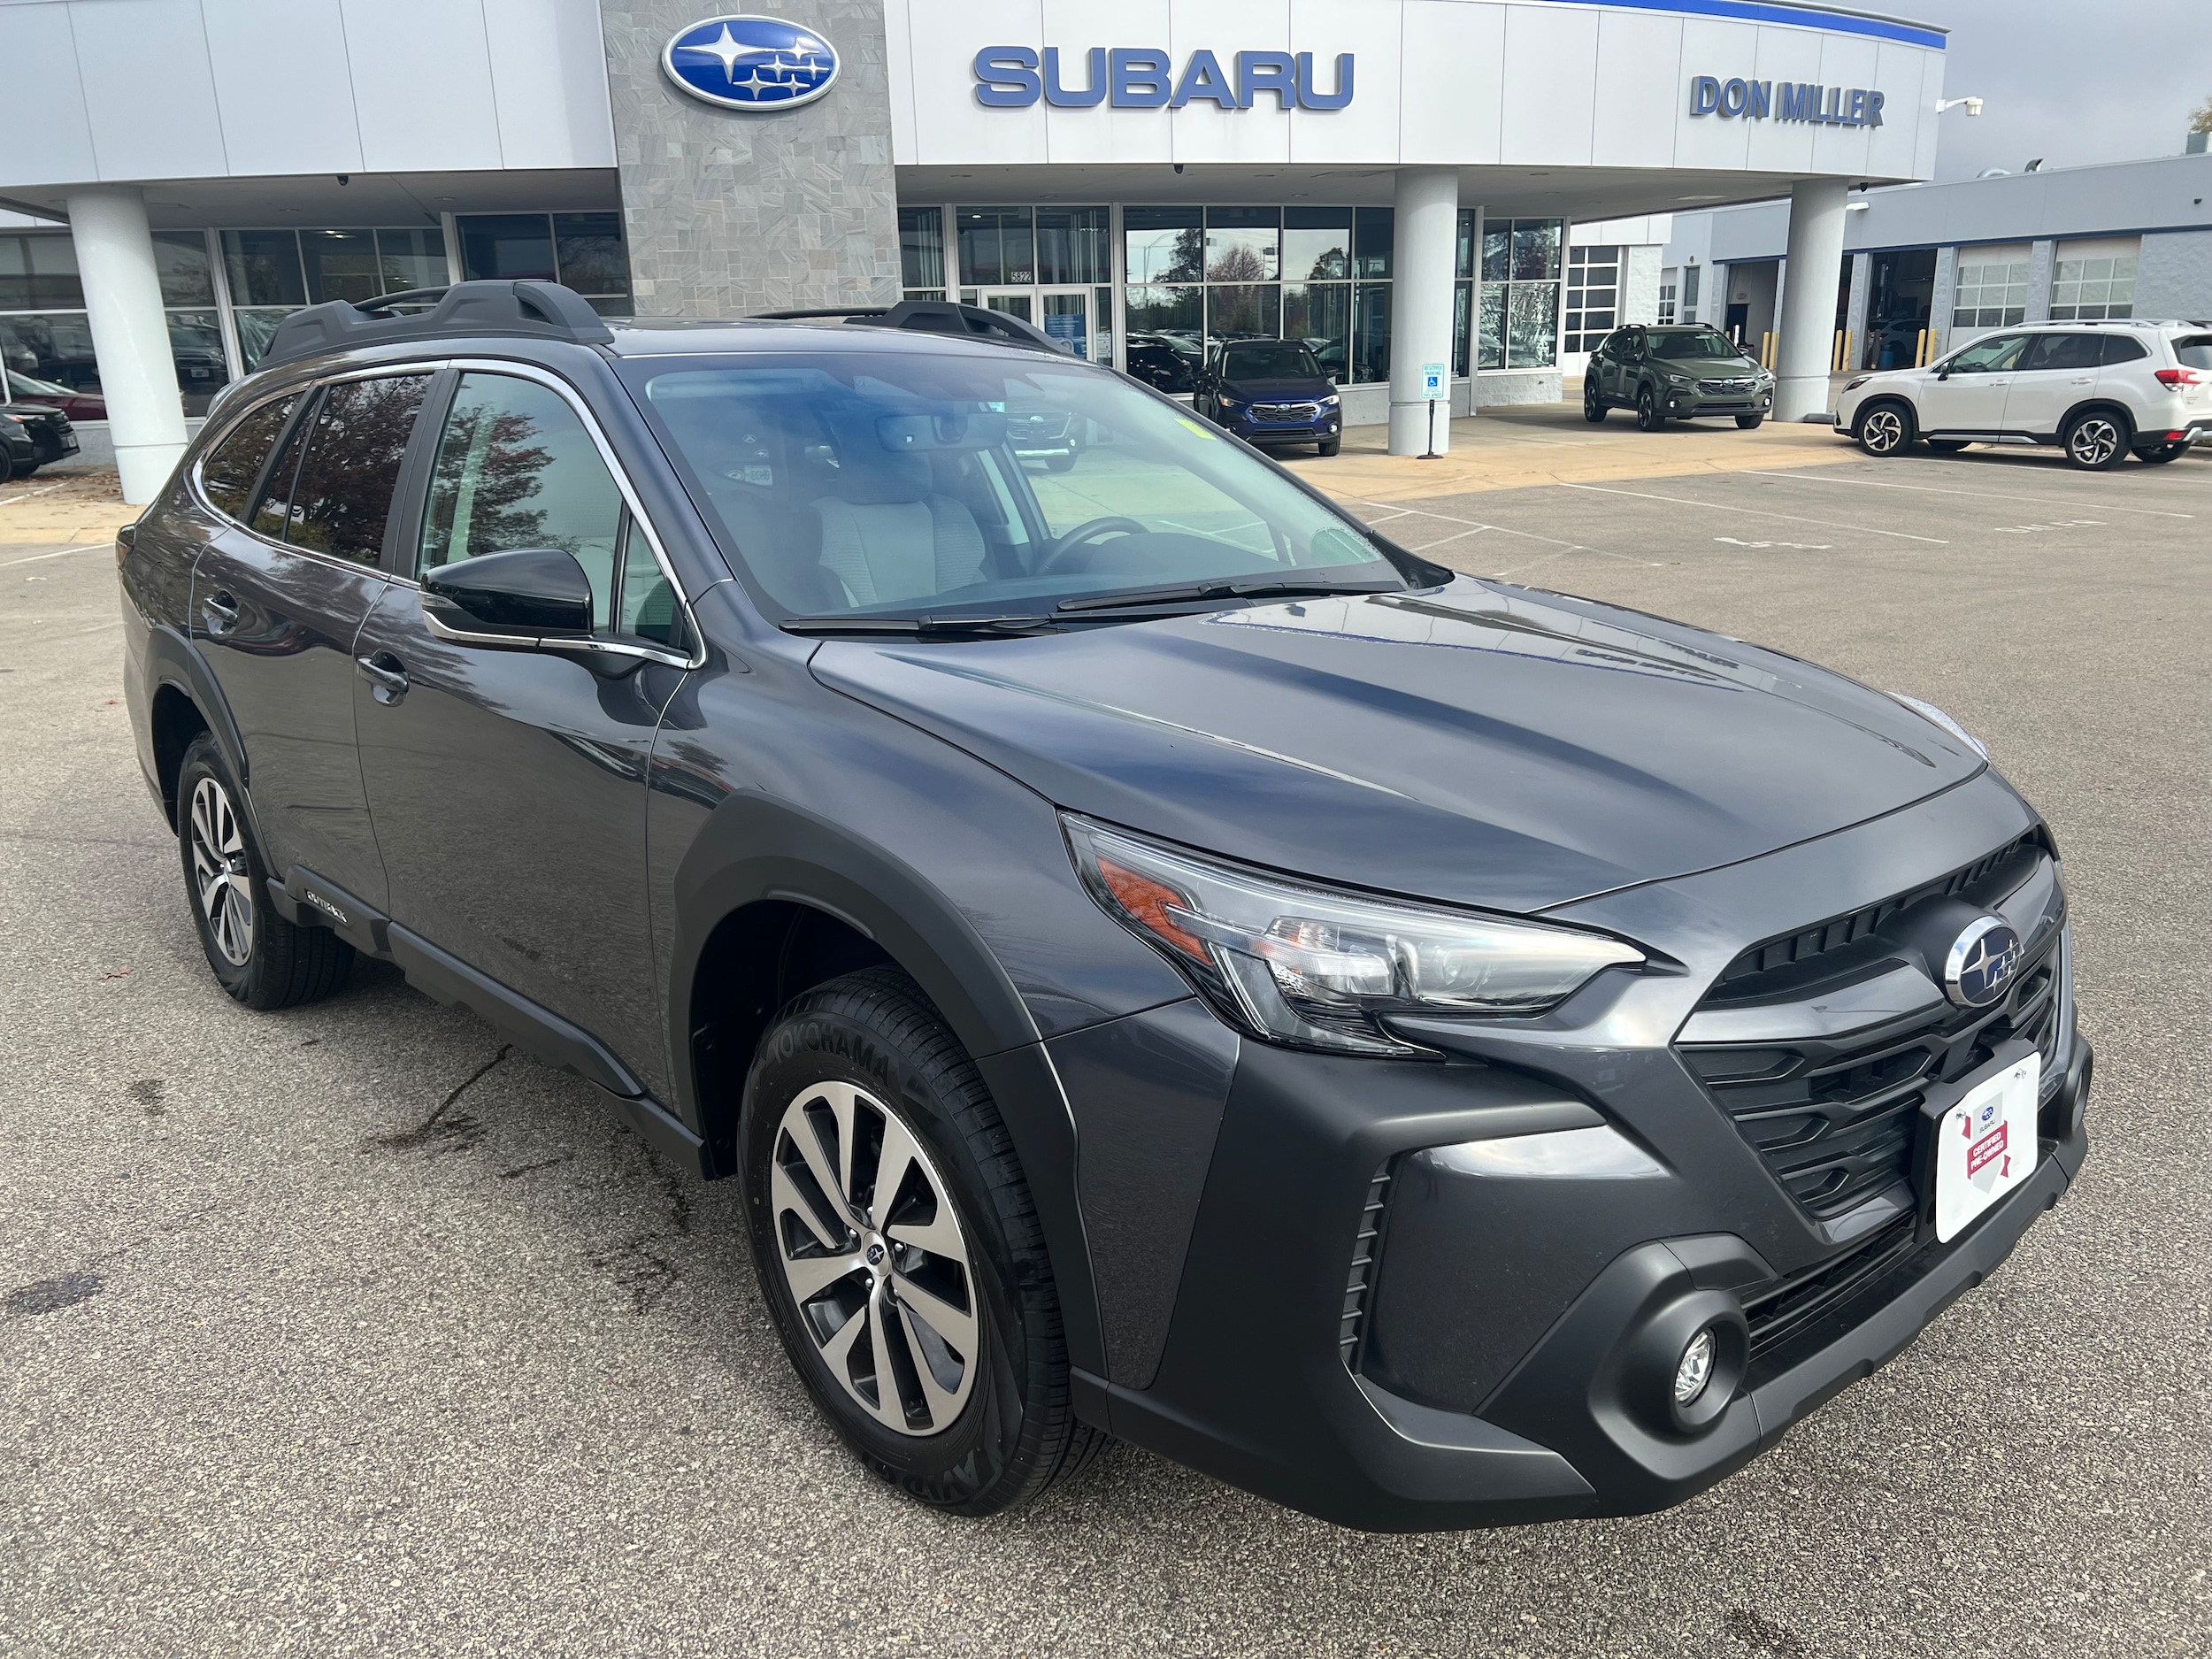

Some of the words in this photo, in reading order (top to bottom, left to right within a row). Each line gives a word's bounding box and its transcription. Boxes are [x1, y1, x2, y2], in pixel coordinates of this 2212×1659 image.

[974, 46, 1355, 110] SUBARU
[1691, 76, 1771, 119] DON
[1775, 82, 1885, 127] MILLER
[1011, 272, 1031, 282] 5822
[770, 1022, 889, 1087] YOKOHAMA
[1970, 1140, 2004, 1171] PRE-OWNED
[1973, 1132, 2001, 1157] CERTIFIED
